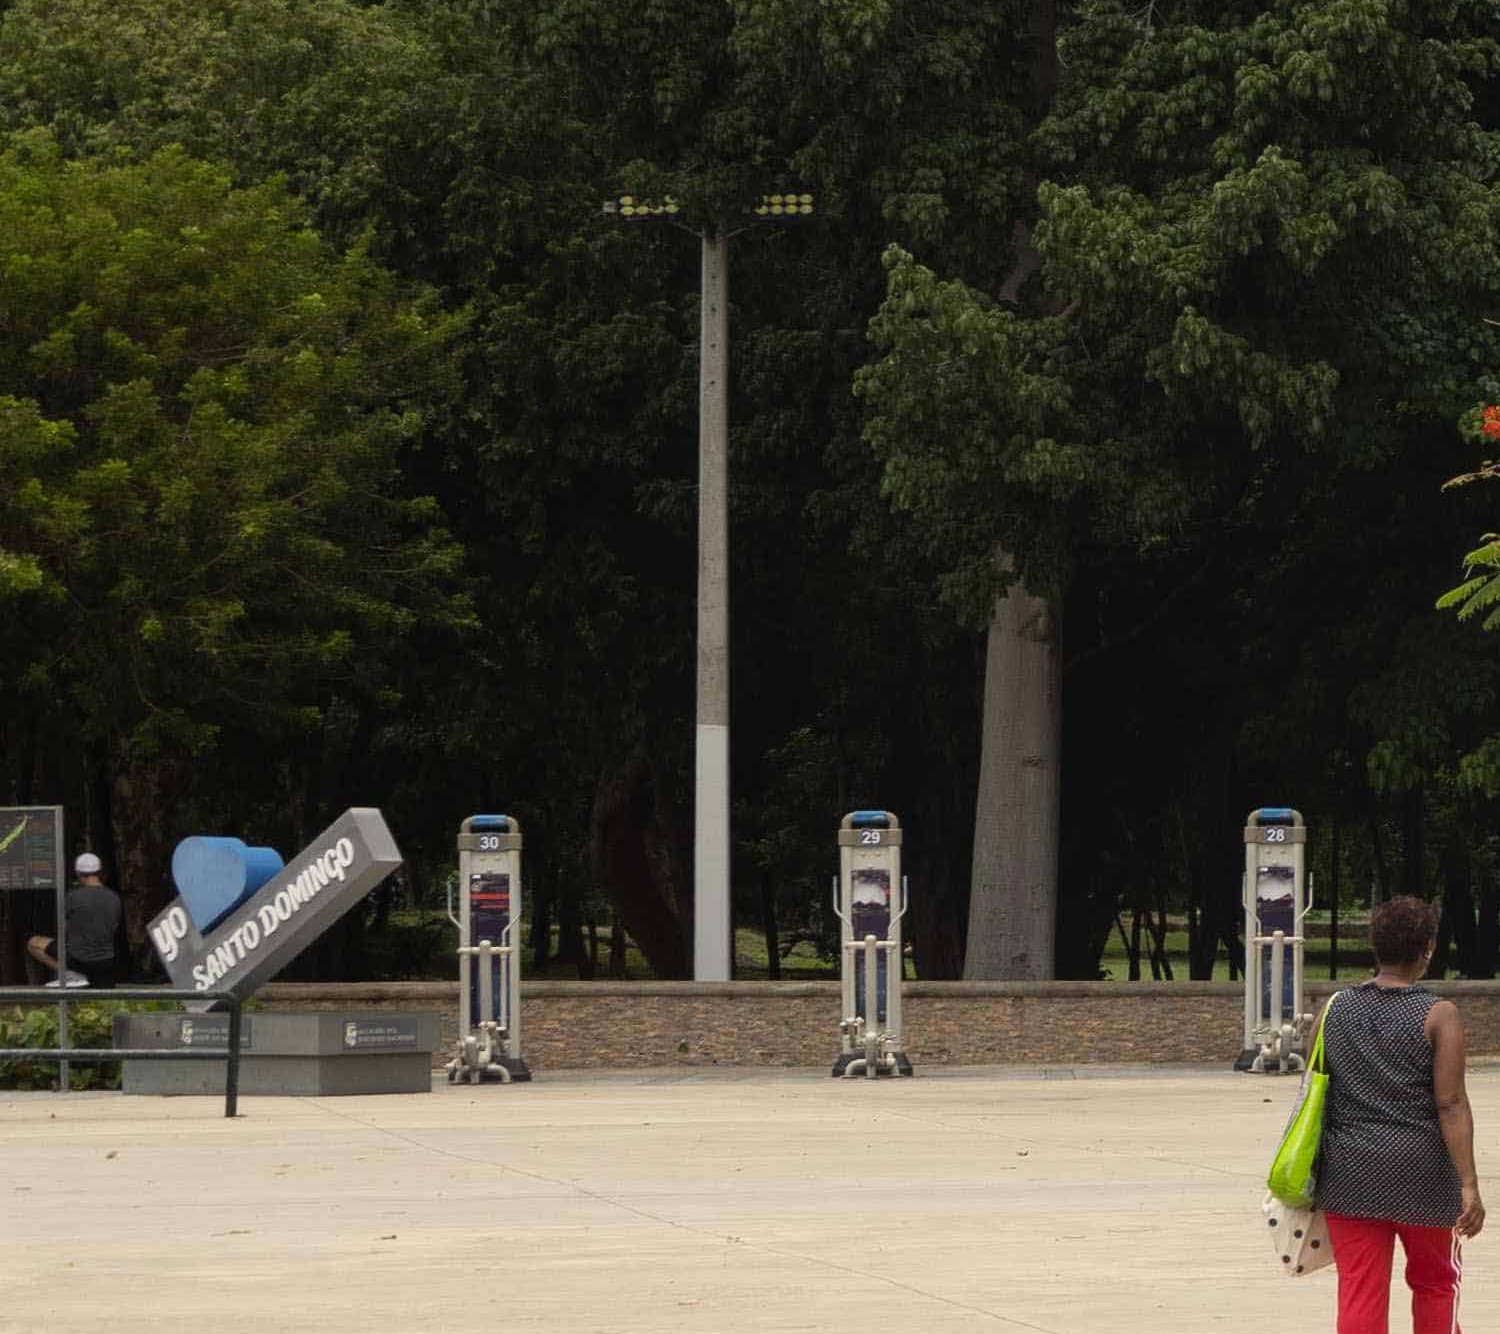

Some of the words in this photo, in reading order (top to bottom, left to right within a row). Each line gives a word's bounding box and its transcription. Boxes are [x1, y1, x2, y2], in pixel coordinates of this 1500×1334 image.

[861, 831, 881, 844] 29
[1266, 828, 1285, 842] 28
[479, 836, 499, 849] 30
[192, 920, 262, 992] SANTO
[257, 837, 354, 938] DOMINGO
